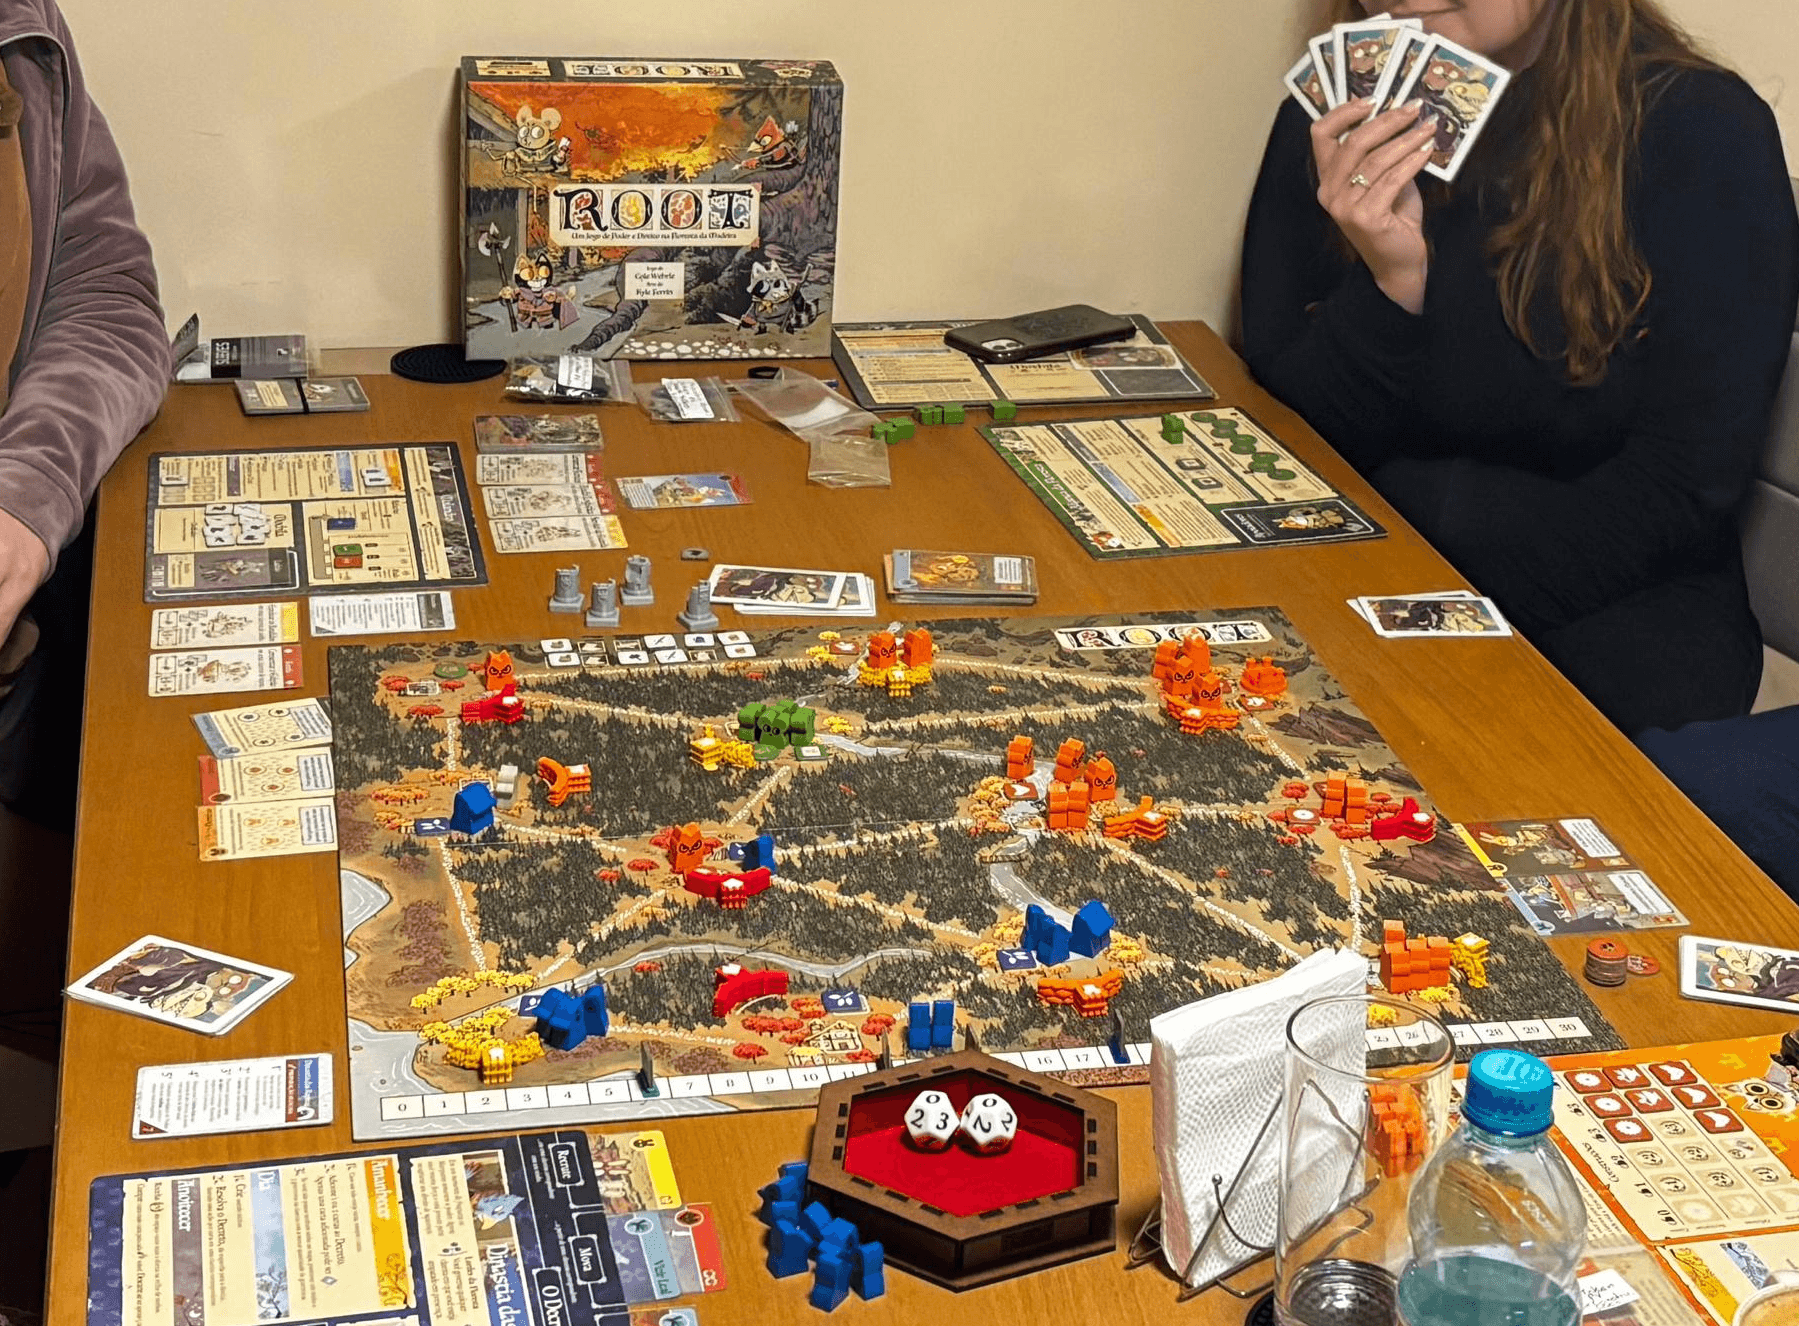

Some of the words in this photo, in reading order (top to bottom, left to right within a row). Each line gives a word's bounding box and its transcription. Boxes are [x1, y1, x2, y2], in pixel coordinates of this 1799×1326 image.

[554, 188, 754, 232] ROOT
[1058, 622, 1261, 648] ROOT
[1558, 1023, 1577, 1032] 30
[1074, 1052, 1090, 1064] 17
[398, 1103, 407, 1112] 0
[482, 1096, 490, 1105] 2
[523, 1094, 532, 1102] 3
[605, 1088, 613, 1096] 5
[686, 1082, 694, 1090] 7
[726, 1078, 735, 1088] 8
[766, 1076, 774, 1085] 9
[803, 1073, 819, 1082] 10
[926, 1094, 940, 1104] 0
[982, 1098, 997, 1107] 0
[910, 1108, 924, 1129] 2
[936, 1112, 949, 1130] 3
[1001, 1112, 1013, 1132] 2
[557, 1150, 572, 1179] Recrute
[235, 1184, 246, 1198] Crie
[258, 1172, 275, 1191] Dia
[370, 1160, 391, 1220] Amanhecer
[178, 1179, 194, 1231] Anoitecer
[216, 1186, 227, 1211] Resolva
[578, 1246, 594, 1272] Mova
[486, 1244, 514, 1304] Dinastia
[542, 1285, 560, 1298] O
